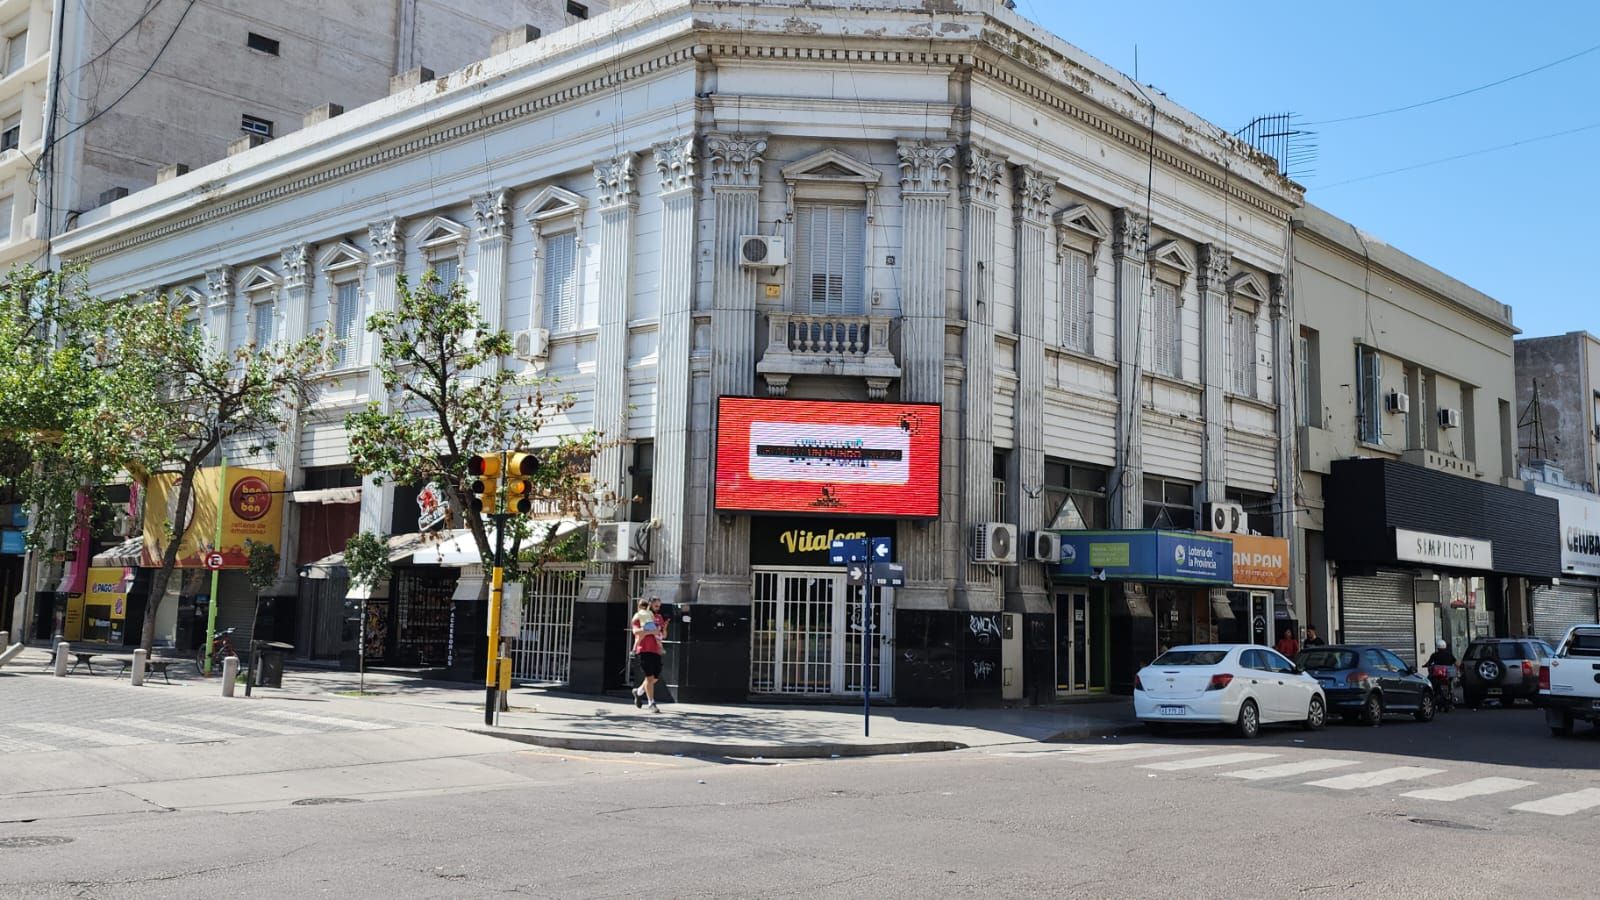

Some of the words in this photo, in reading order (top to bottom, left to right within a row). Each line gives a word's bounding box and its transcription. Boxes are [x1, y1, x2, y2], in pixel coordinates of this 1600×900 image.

[241, 502, 260, 512] bon
[1206, 547, 1213, 558] de
[1417, 537, 1475, 560] SIMPLICITY
[1188, 556, 1194, 567] la
[1194, 558, 1217, 569] Provincia
[1253, 554, 1283, 569] PAN
